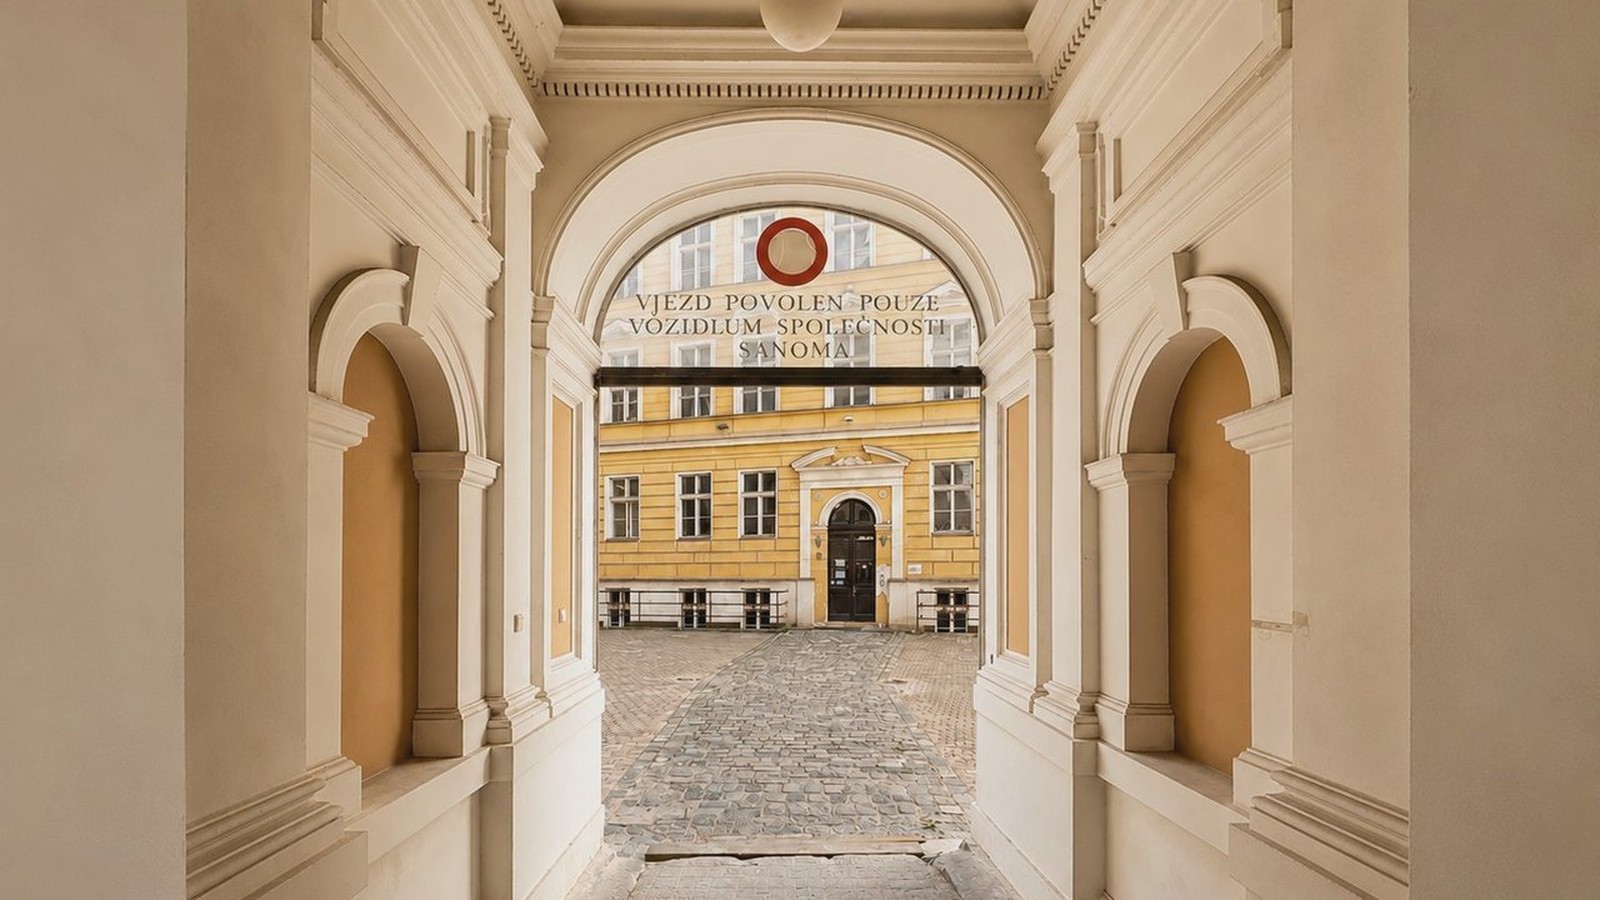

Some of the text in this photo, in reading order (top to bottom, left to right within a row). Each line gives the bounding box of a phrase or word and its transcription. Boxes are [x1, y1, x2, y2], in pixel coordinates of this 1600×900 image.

[636, 294, 939, 316] VJEZD POVOLEN POUZE
[629, 318, 762, 335] VOZIDLUM
[739, 341, 849, 359] SANOMA
